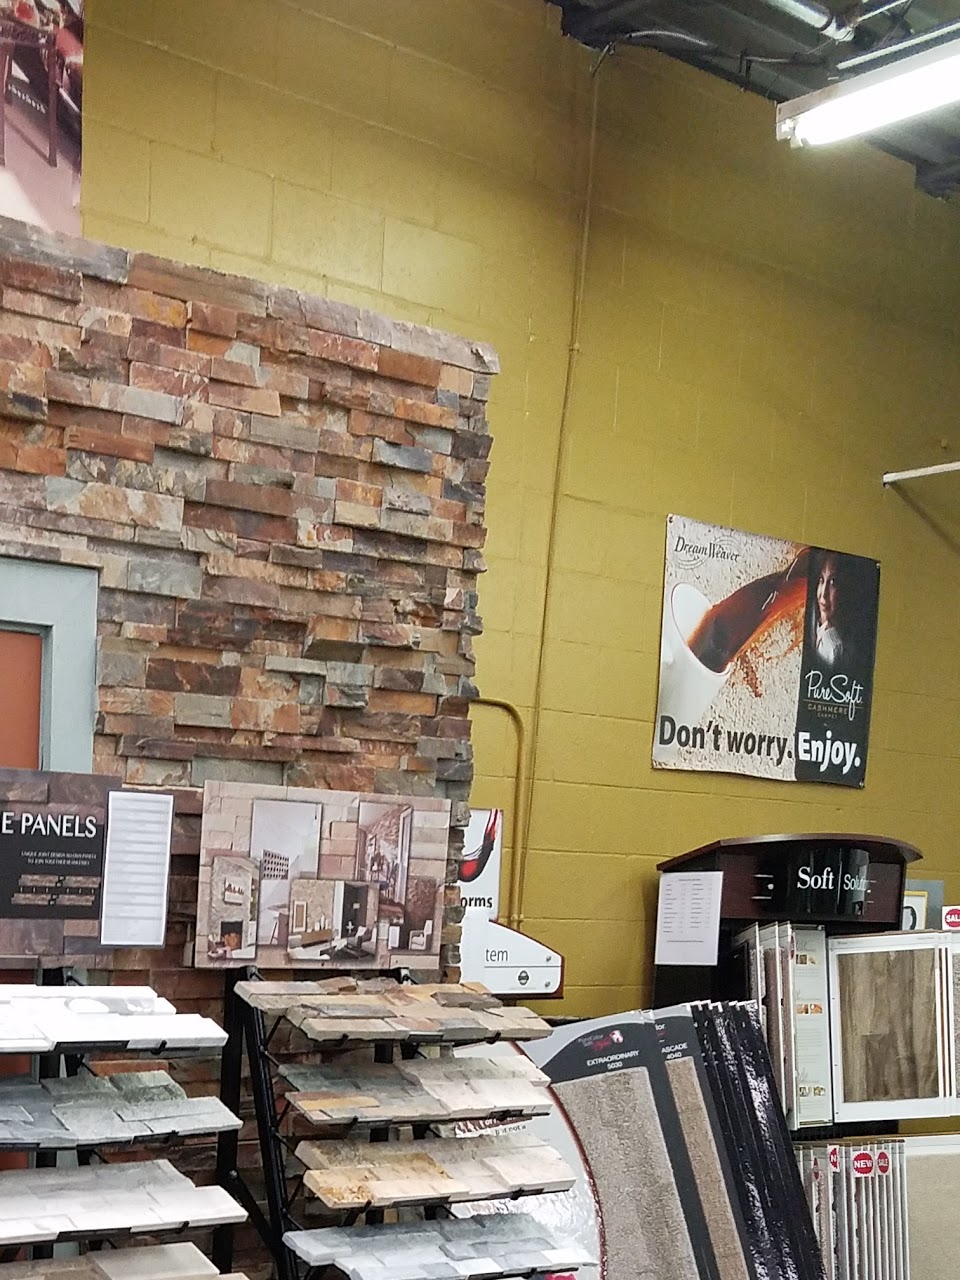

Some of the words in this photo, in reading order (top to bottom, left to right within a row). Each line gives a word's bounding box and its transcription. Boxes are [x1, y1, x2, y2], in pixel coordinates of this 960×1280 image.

[807, 703, 848, 715] CASHMERE
[659, 715, 722, 751] Don't
[727, 729, 793, 767] worry.
[798, 730, 861, 775] Enjoy.
[21, 812, 97, 838] PANELS
[797, 866, 835, 889] Soft
[945, 914, 960, 923] SAL
[485, 948, 509, 962] tem
[586, 1050, 639, 1067] EXTRAORDINARY
[854, 1160, 874, 1168] NEW
